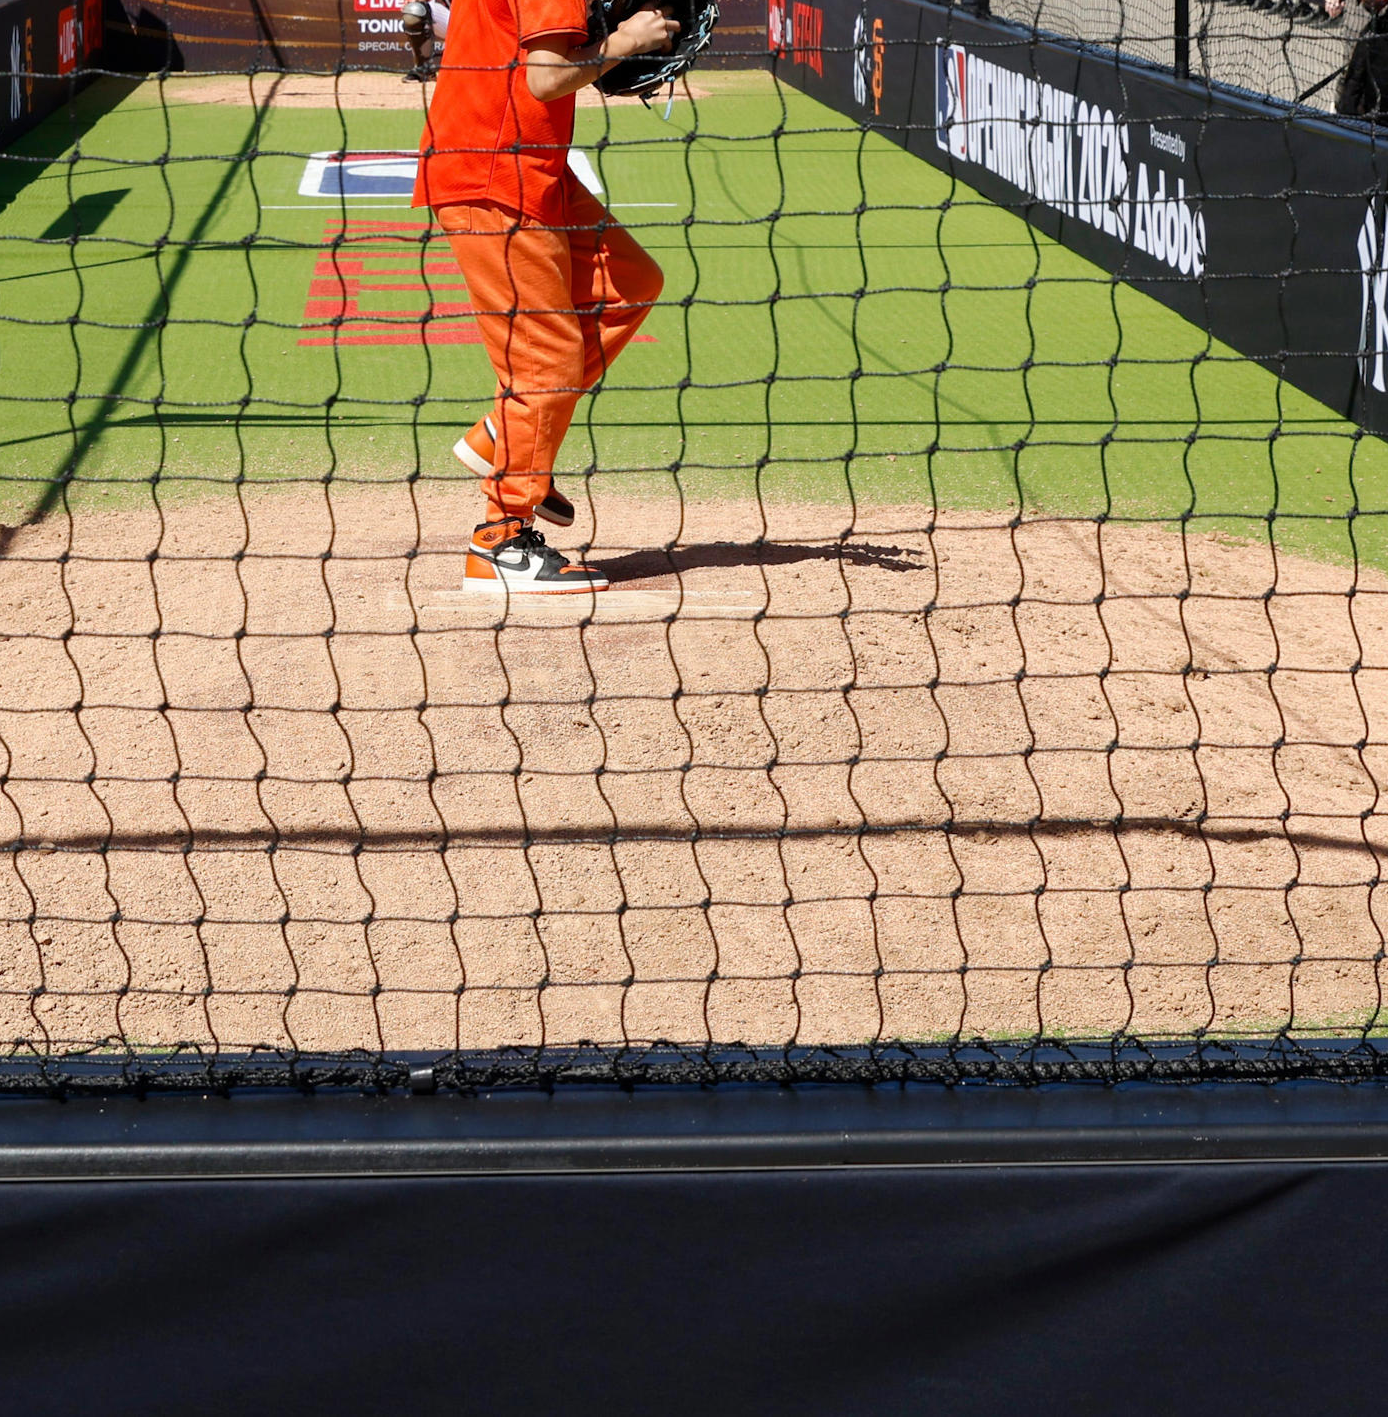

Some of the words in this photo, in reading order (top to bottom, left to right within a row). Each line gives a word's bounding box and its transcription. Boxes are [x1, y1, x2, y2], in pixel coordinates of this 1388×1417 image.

[357, 18, 405, 33] TONI
[357, 41, 402, 52] SPECIAL
[966, 53, 1026, 192] OPENING
[1025, 77, 1078, 219] NIGHT
[1076, 99, 1130, 244] 2026
[1150, 123, 1178, 156] Presented
[1133, 161, 1207, 279] Adobe
